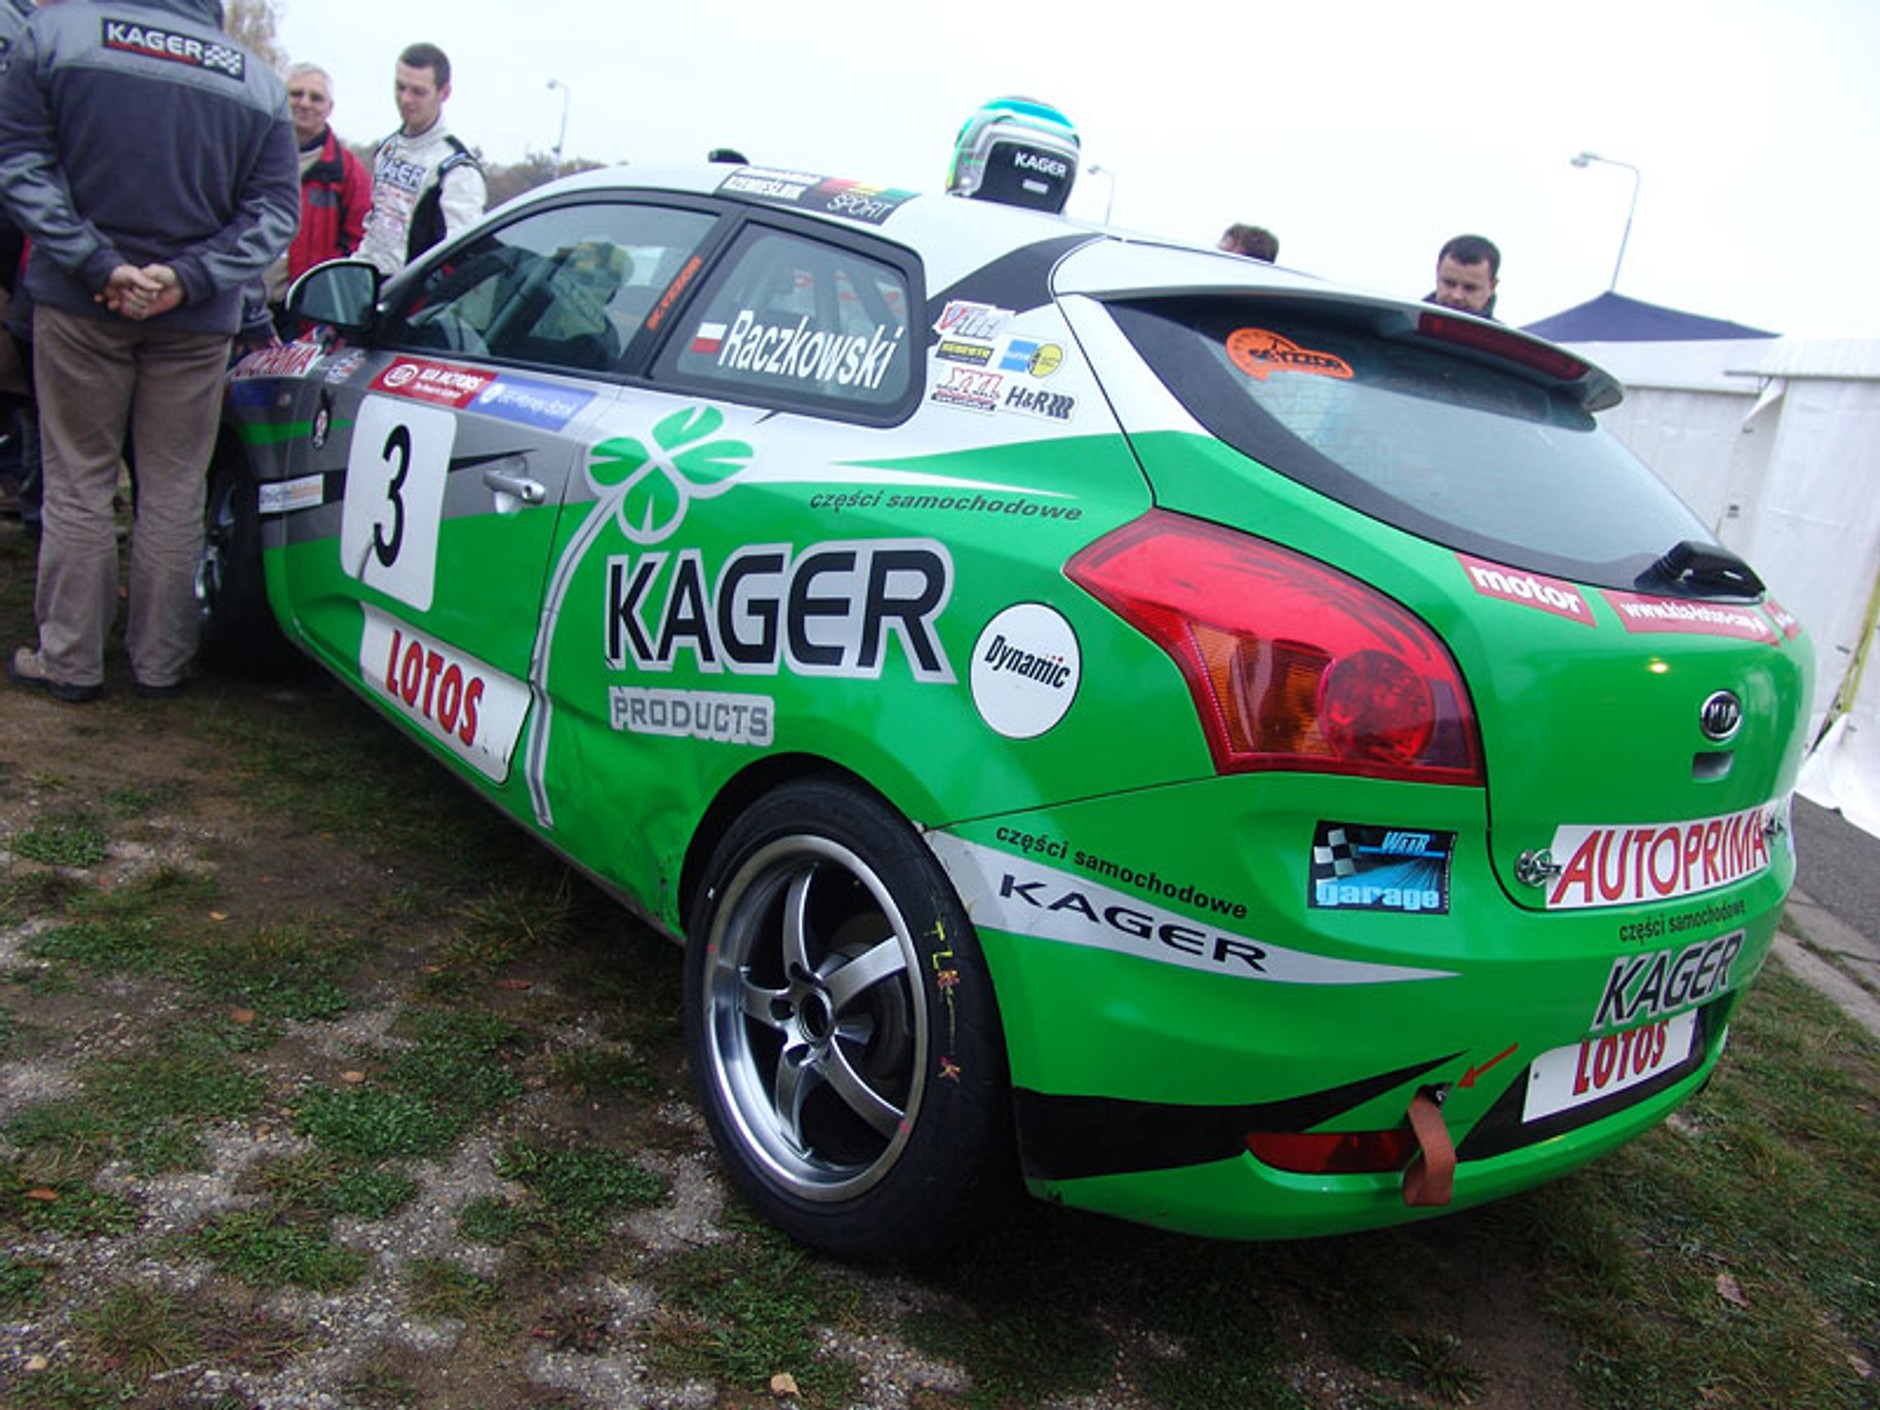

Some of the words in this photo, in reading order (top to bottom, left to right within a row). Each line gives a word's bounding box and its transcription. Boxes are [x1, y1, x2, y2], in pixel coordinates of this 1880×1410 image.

[107, 22, 204, 59] KAGER
[1014, 151, 1067, 178] KAGER
[827, 193, 895, 220] SPORT
[716, 310, 906, 390] Raczkowski
[1004, 385, 1049, 413] H&R
[373, 424, 412, 568] 3
[809, 490, 885, 513] części
[886, 492, 1083, 522] samochodowe
[602, 543, 951, 679] KAGER
[1468, 564, 1583, 615] motor
[386, 628, 486, 747] LOTOS
[984, 634, 1071, 689] Dynamic
[613, 696, 769, 738] PRODUCTS
[996, 826, 1068, 860] części
[1073, 848, 1248, 919] samochodowe
[1549, 808, 1769, 904] AUTOPRIMA
[1000, 873, 1267, 973] KAGER
[1619, 913, 1666, 946] części
[1668, 899, 1746, 934] samochodowe
[1593, 930, 1745, 1029] KAGER
[1572, 1018, 1670, 1096] LOTOS
